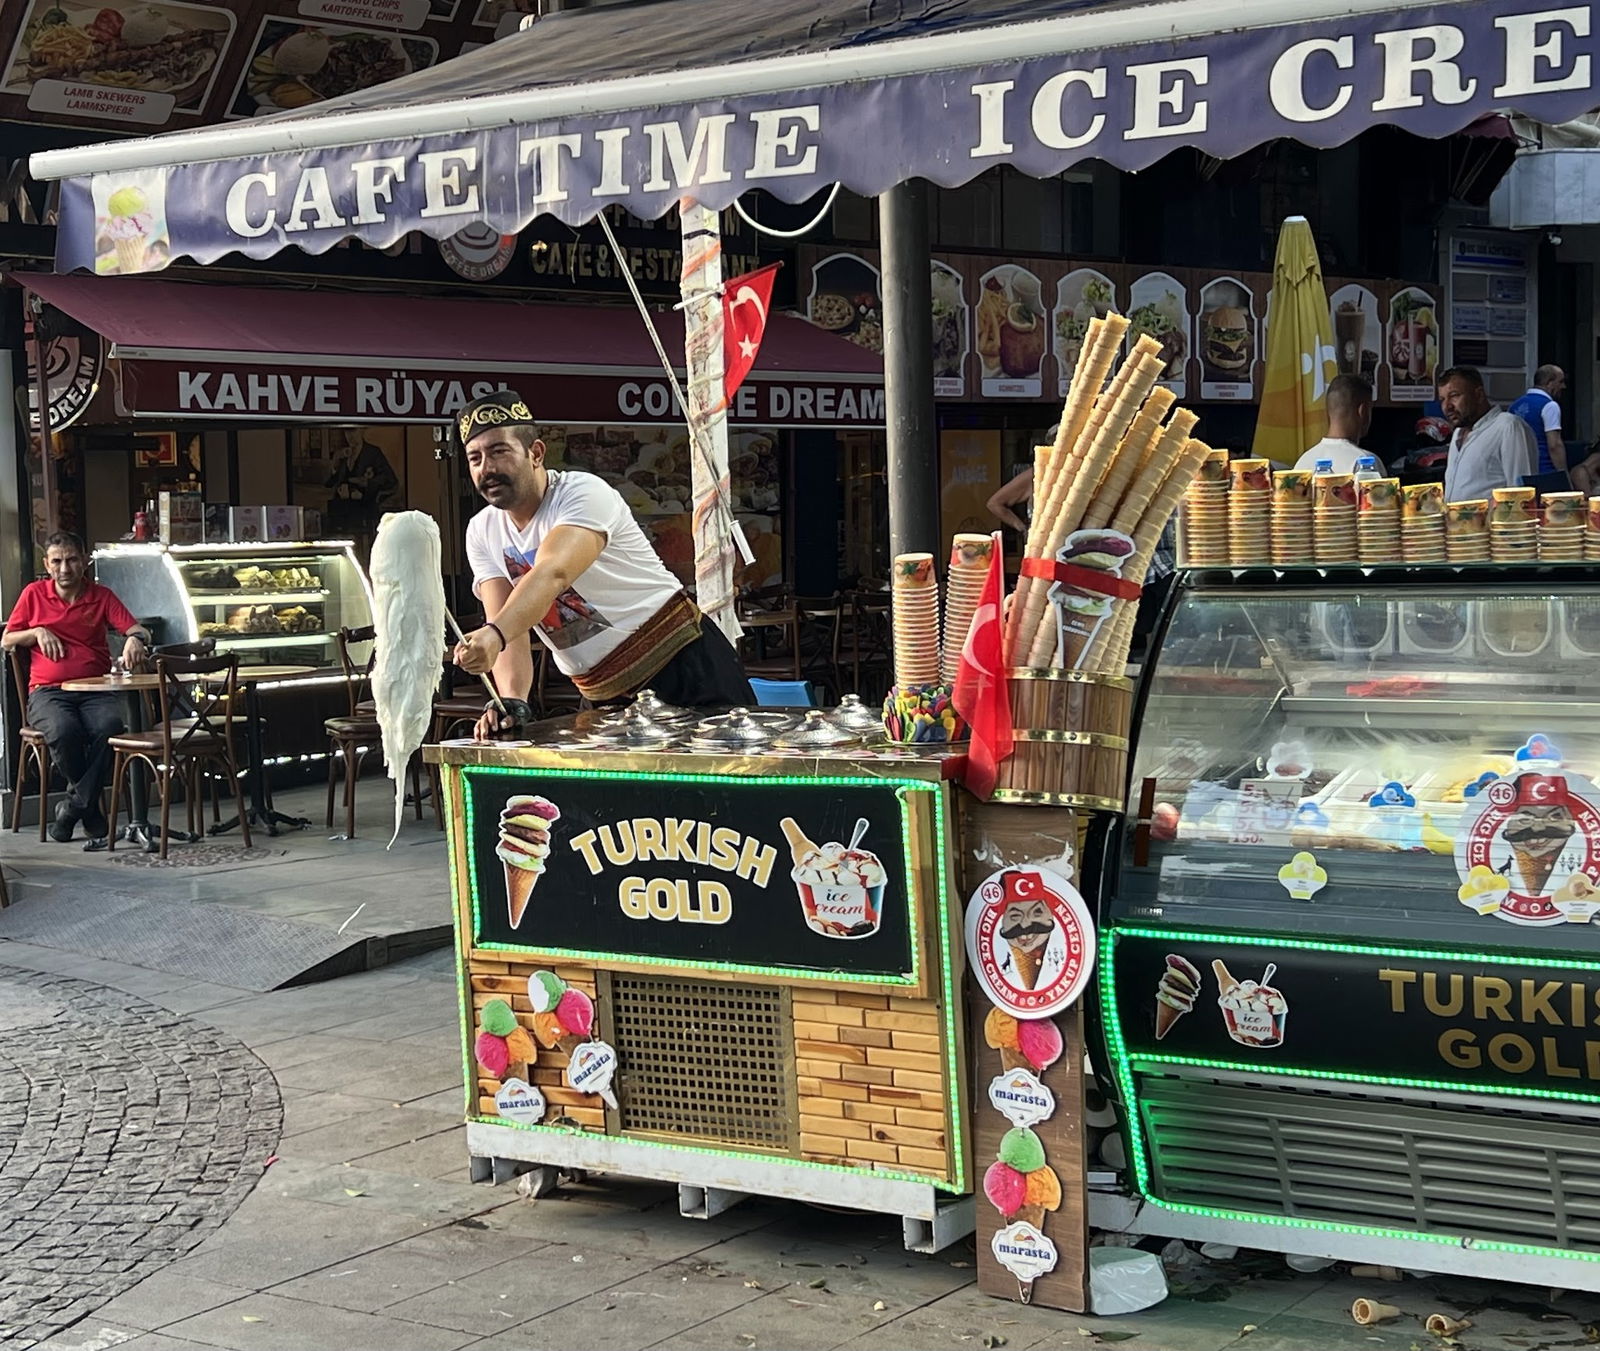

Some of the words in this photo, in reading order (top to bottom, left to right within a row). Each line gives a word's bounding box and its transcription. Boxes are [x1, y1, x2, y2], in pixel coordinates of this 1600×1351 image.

[321, 4, 374, 18] KARTOFFEL
[375, 12, 404, 23] CHIPS
[64, 87, 95, 98] LAMB
[95, 91, 147, 105] SKEWERS
[969, 56, 1209, 159] ICE
[225, 146, 480, 238] CAFE
[519, 104, 821, 204] TIME
[49, 355, 96, 426] DREAM
[177, 371, 341, 414] KAHVE
[355, 371, 508, 416] RÜYA
[769, 386, 886, 419] DREAM
[1491, 786, 1512, 800] 46
[569, 817, 778, 889] TURKISH
[618, 876, 733, 924] GOLD
[826, 888, 852, 902] ice
[983, 887, 1000, 899] 46
[815, 902, 865, 915] cream
[981, 908, 998, 934] BIG
[980, 935, 991, 961] ICE
[986, 963, 1018, 1004] CREAM
[1045, 959, 1080, 1000] YAKUP
[1237, 1022, 1272, 1033] cream
[1243, 1013, 1263, 1024] ice
[573, 1052, 612, 1085] marasta
[499, 1098, 541, 1109] marasta
[994, 1088, 1048, 1107] marasta
[999, 1242, 1051, 1260] marasta
